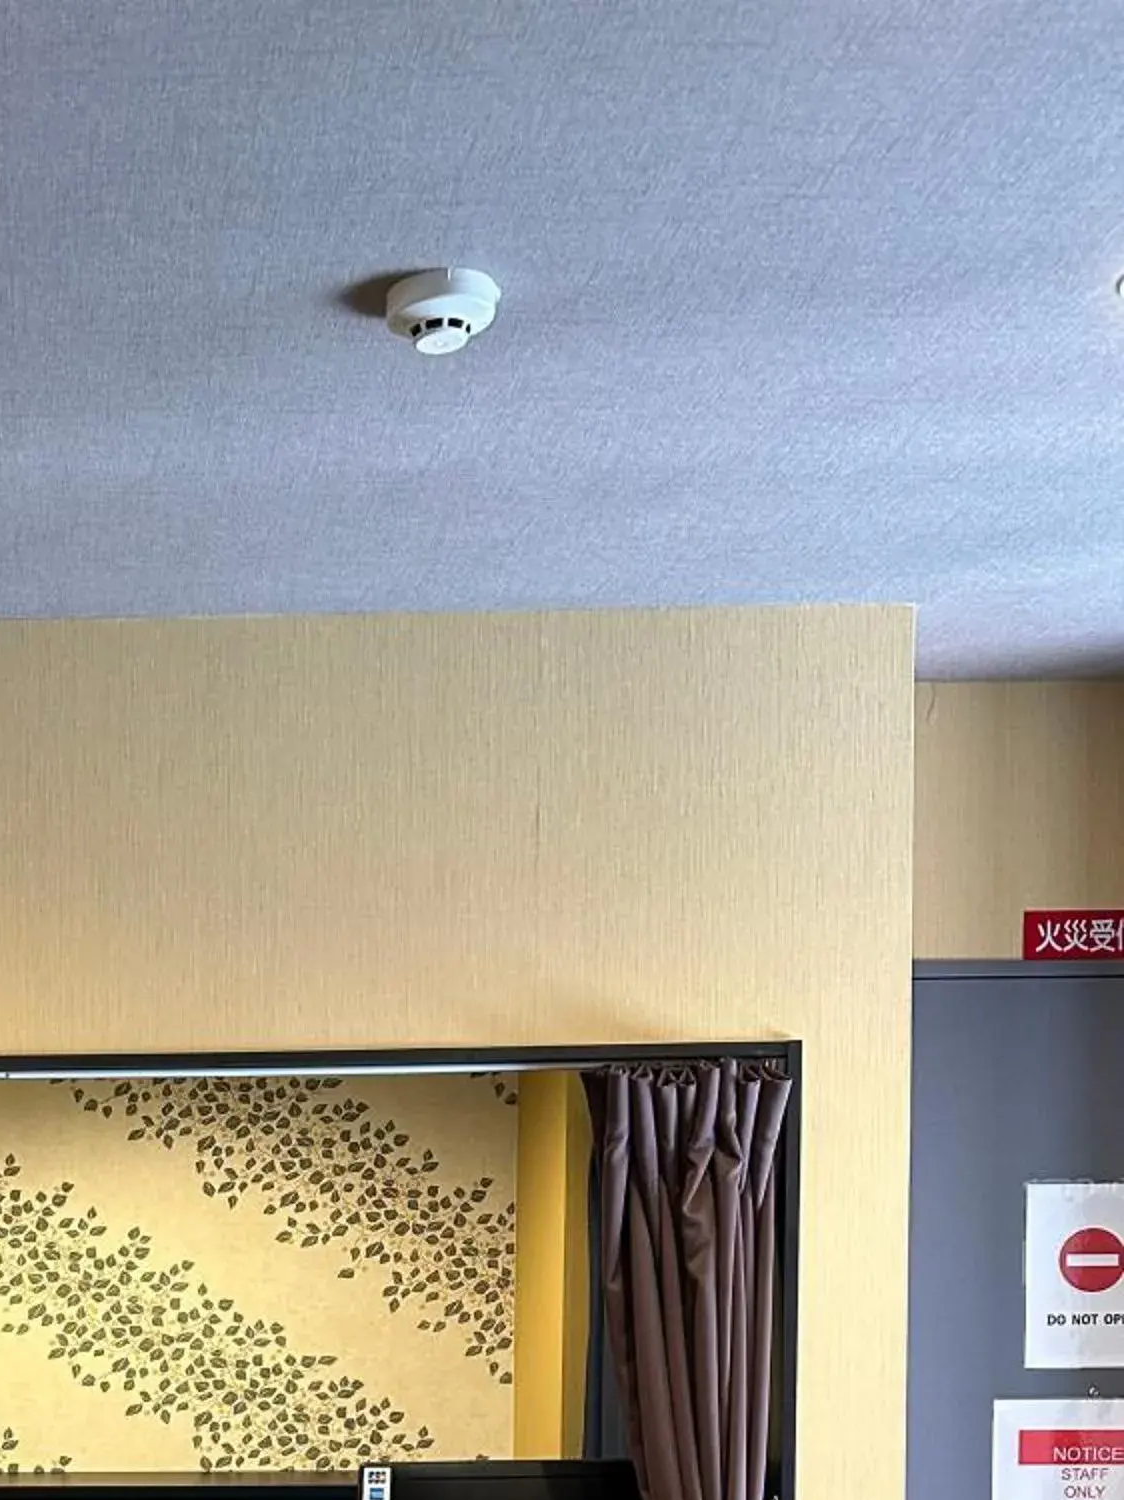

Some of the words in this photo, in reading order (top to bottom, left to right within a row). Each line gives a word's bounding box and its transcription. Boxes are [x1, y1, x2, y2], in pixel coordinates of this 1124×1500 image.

[1047, 1313, 1066, 1326] DO
[1071, 1313, 1098, 1325] NOT
[1104, 1313, 1124, 1325] OP
[1053, 1447, 1124, 1461] NOTICE
[1061, 1467, 1108, 1481] STAFF
[1064, 1485, 1106, 1498] ONLY
